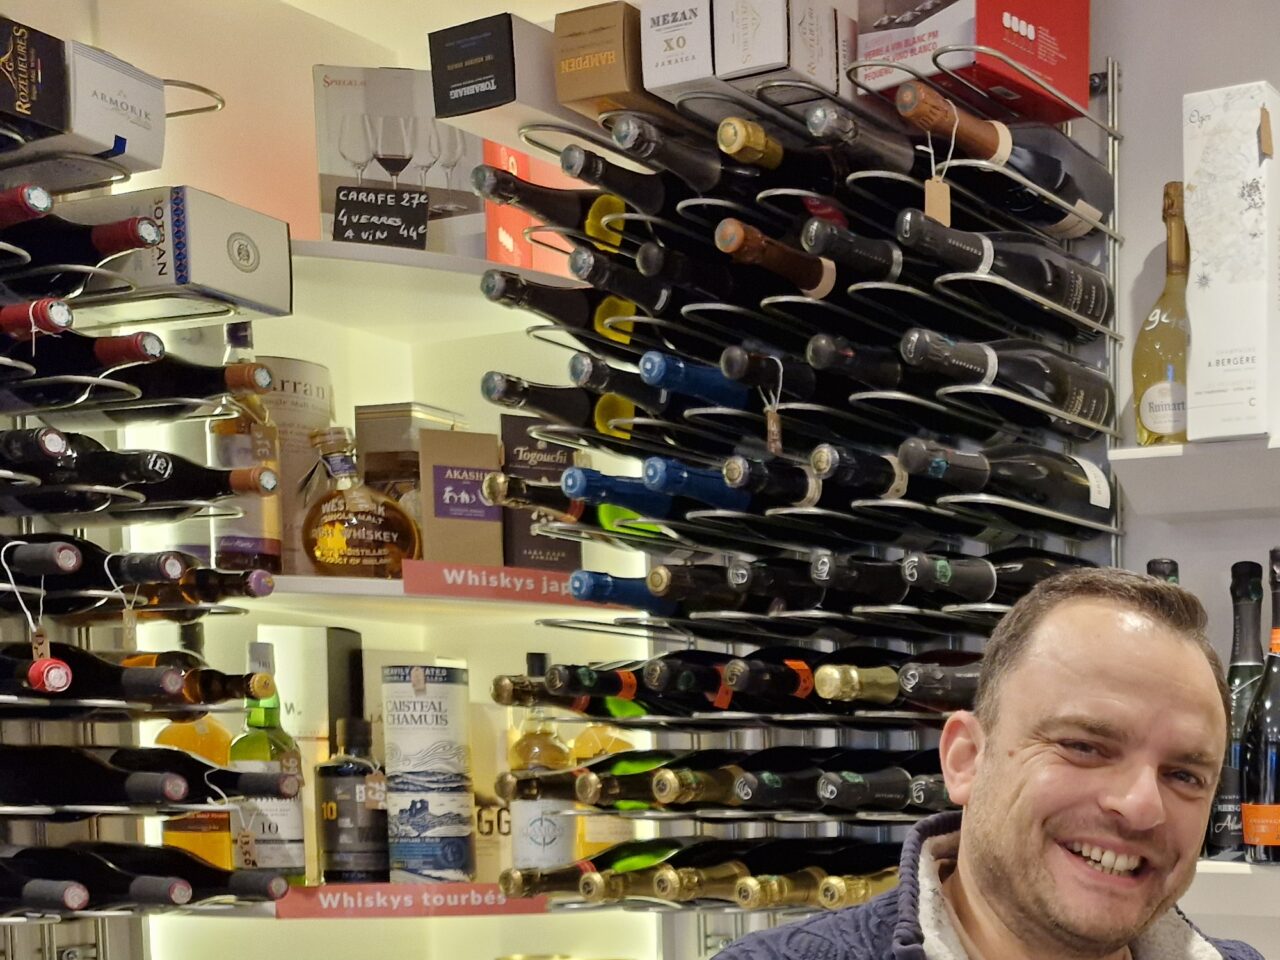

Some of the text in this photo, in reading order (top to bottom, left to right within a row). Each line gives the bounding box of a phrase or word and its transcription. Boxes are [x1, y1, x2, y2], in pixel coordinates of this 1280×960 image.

[650, 8, 698, 28] MEZAN
[664, 36, 687, 52] XO
[560, 51, 617, 74] HAMPDEN
[655, 55, 697, 68] JAMAICA
[92, 90, 152, 120] ARMORIK
[339, 190, 396, 206] CARAFE
[273, 378, 326, 400] rran
[513, 447, 568, 465] Togouchi
[443, 568, 535, 592] Whiskys
[321, 801, 338, 820] 10
[260, 821, 279, 835] 10
[318, 888, 507, 910] Whiskys tourbés
